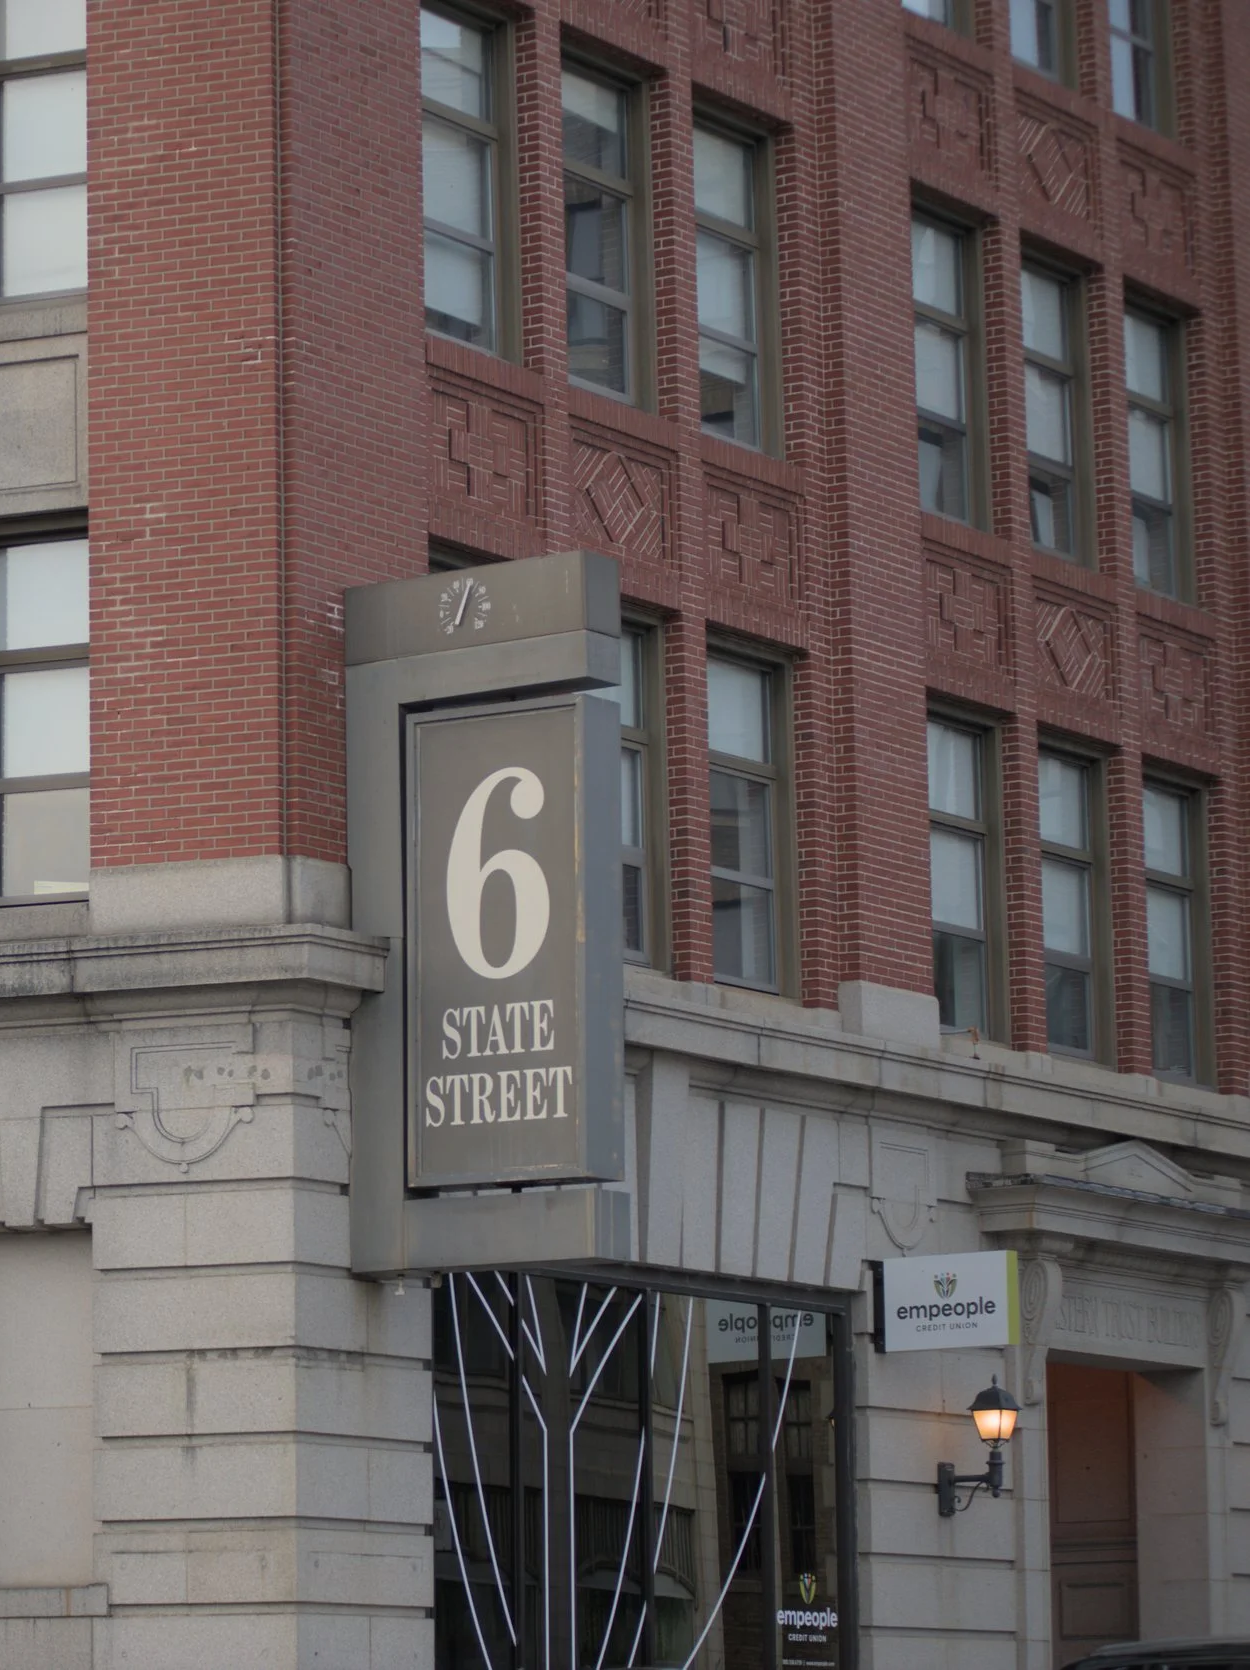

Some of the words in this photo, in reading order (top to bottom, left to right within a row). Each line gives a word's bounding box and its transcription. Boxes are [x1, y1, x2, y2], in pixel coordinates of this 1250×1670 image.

[445, 766, 551, 980] 6
[441, 999, 554, 1060] STATE
[425, 1065, 573, 1128] STREET
[896, 1295, 996, 1321] empeople
[916, 1323, 946, 1333] CREDIT
[949, 1322, 979, 1331] UNION
[776, 1607, 838, 1630] empeople
[788, 1633, 808, 1642] CREDIT
[808, 1634, 827, 1643] UNION
